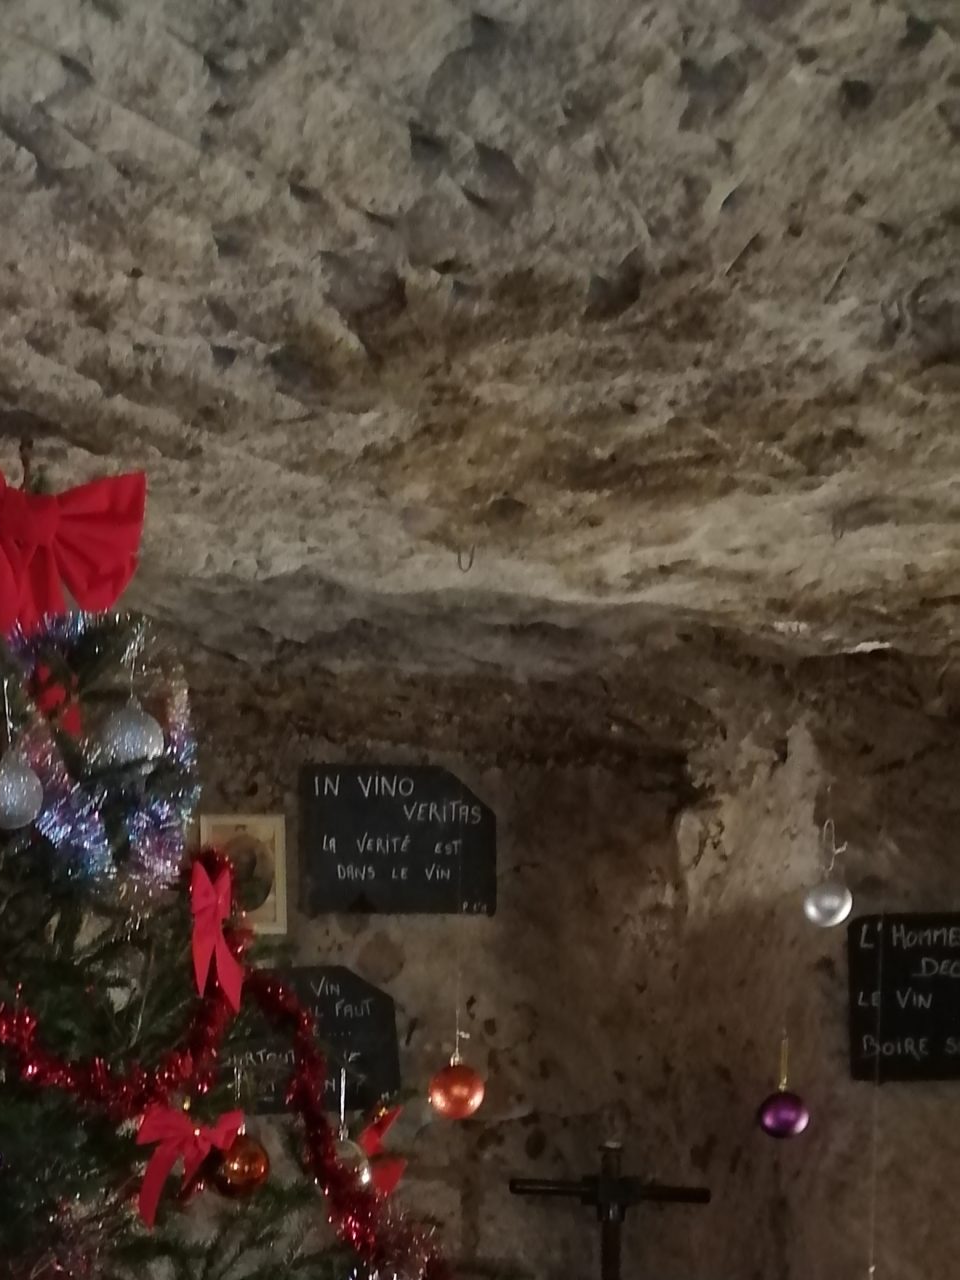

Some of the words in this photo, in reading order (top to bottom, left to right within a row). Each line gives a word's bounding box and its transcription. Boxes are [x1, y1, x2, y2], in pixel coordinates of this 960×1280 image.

[313, 774, 340, 797] IN
[357, 771, 415, 798] VINO
[403, 798, 482, 825] VERITAS
[322, 834, 337, 854] LA
[434, 838, 462, 855] EST
[337, 863, 376, 881] DANS
[391, 866, 408, 880] LE
[425, 864, 451, 881] VIN
[310, 976, 341, 997] VIN
[857, 991, 881, 1008] LE
[895, 986, 935, 1009] VIN
[335, 997, 375, 1019] FAUT
[862, 1034, 931, 1061] BOIRE
